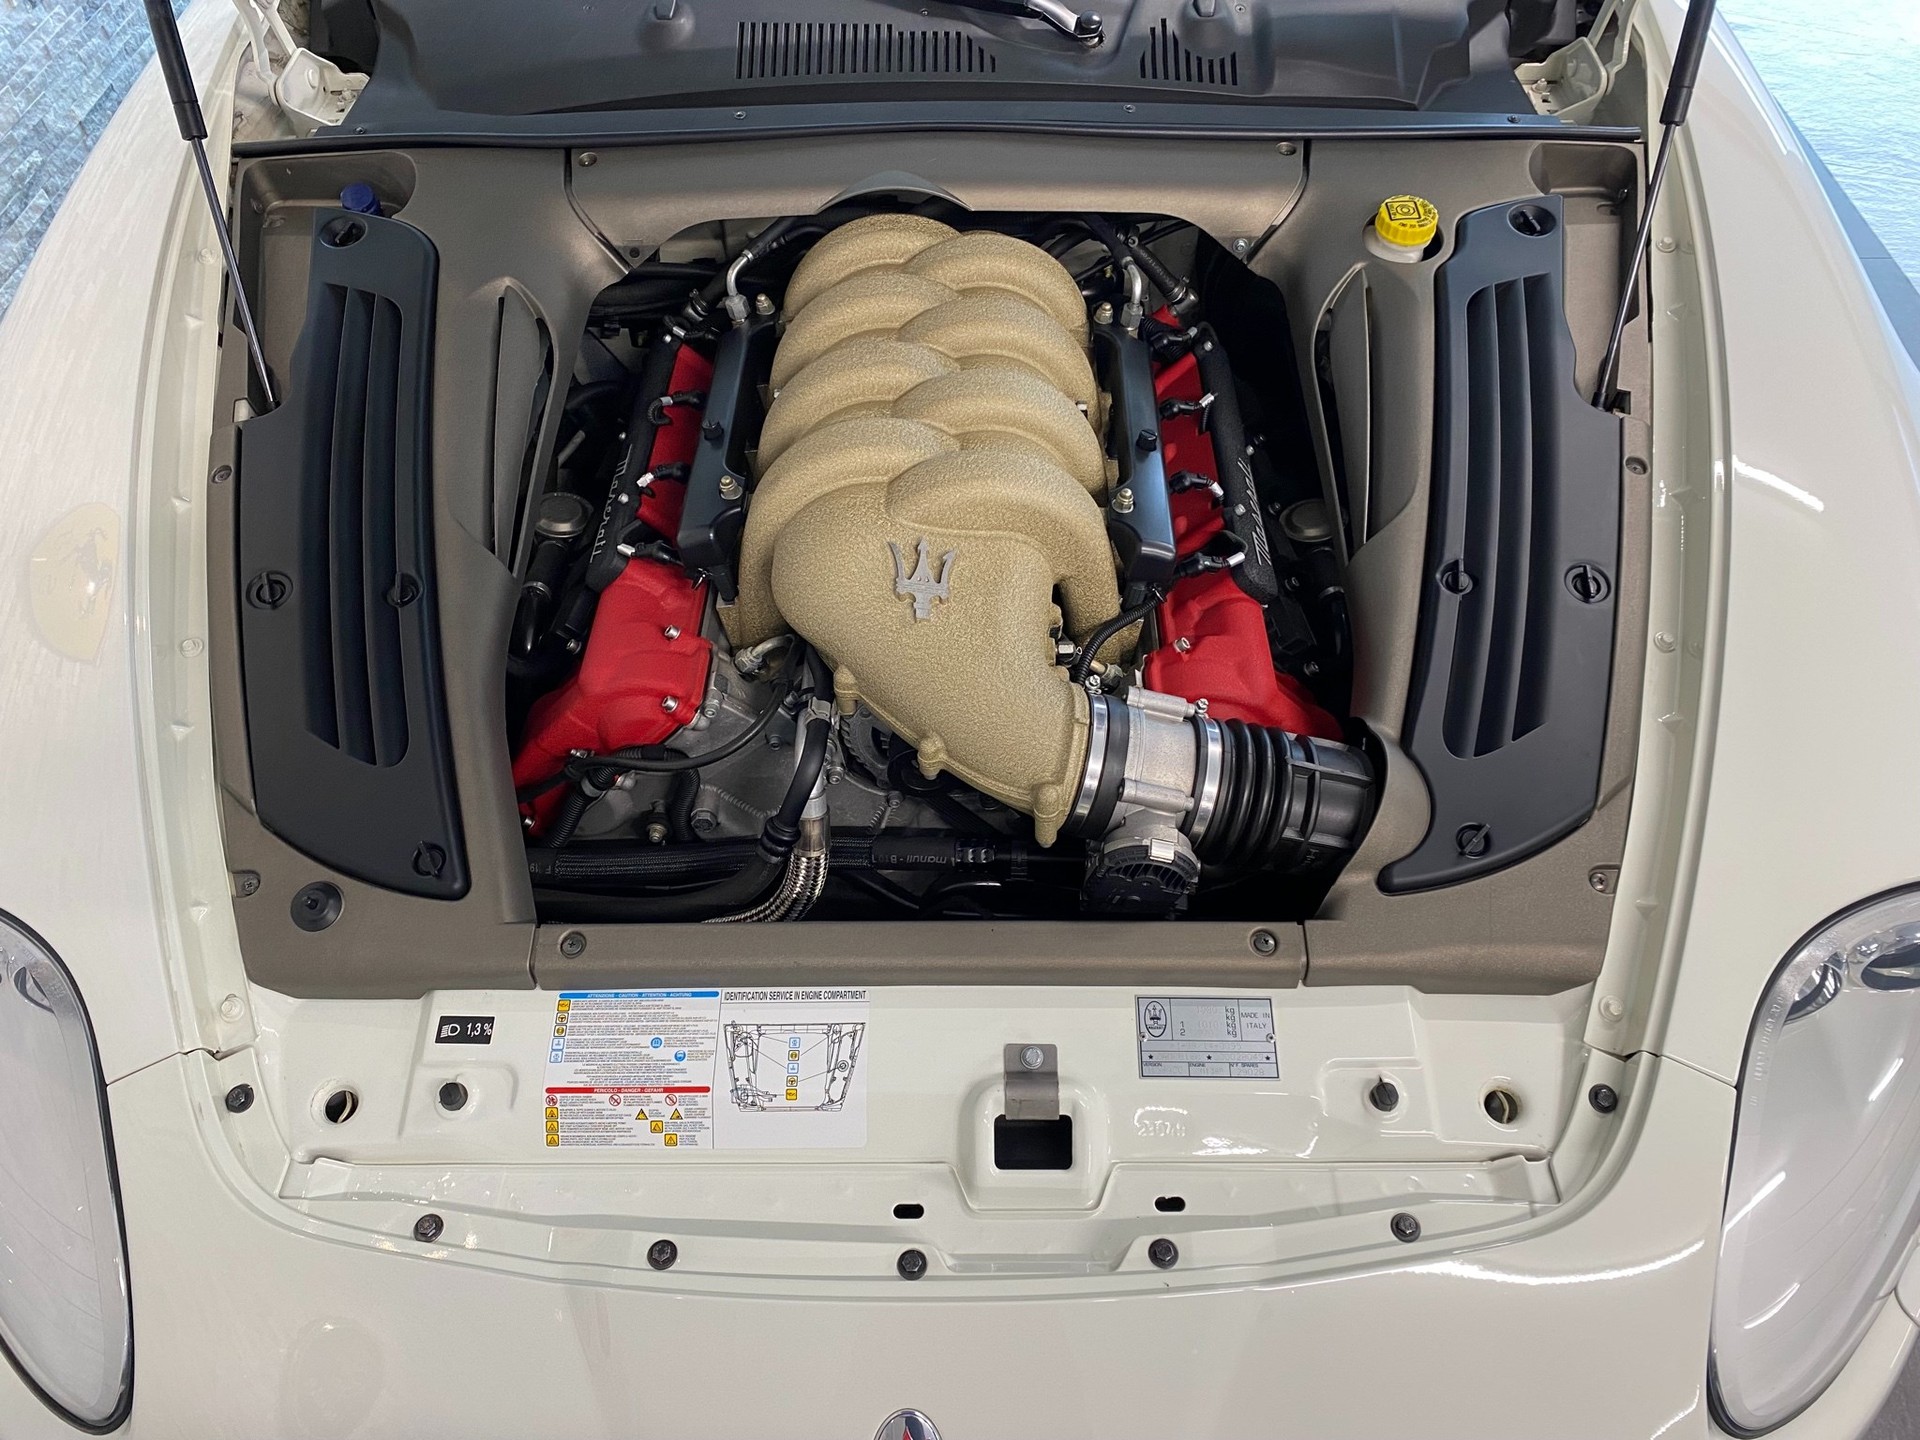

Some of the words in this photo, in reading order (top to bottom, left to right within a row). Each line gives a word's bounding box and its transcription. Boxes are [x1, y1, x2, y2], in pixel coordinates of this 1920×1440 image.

[589, 443, 633, 563] Maserati
[906, 854, 947, 864] manuli
[724, 991, 768, 1001] IDENTIFICATION
[768, 991, 793, 1001] SERVICE
[793, 991, 800, 1000] IN
[801, 991, 822, 1000] ENGINE
[823, 990, 867, 1000] COMPARTMENT
[1224, 1006, 1235, 1015] kg
[1225, 1013, 1236, 1022] kg
[466, 1022, 481, 1037] 1,3
[483, 1023, 492, 1036] %
[1226, 1021, 1236, 1030] kg
[1179, 1028, 1186, 1036] 2
[1227, 1028, 1237, 1038] kg
